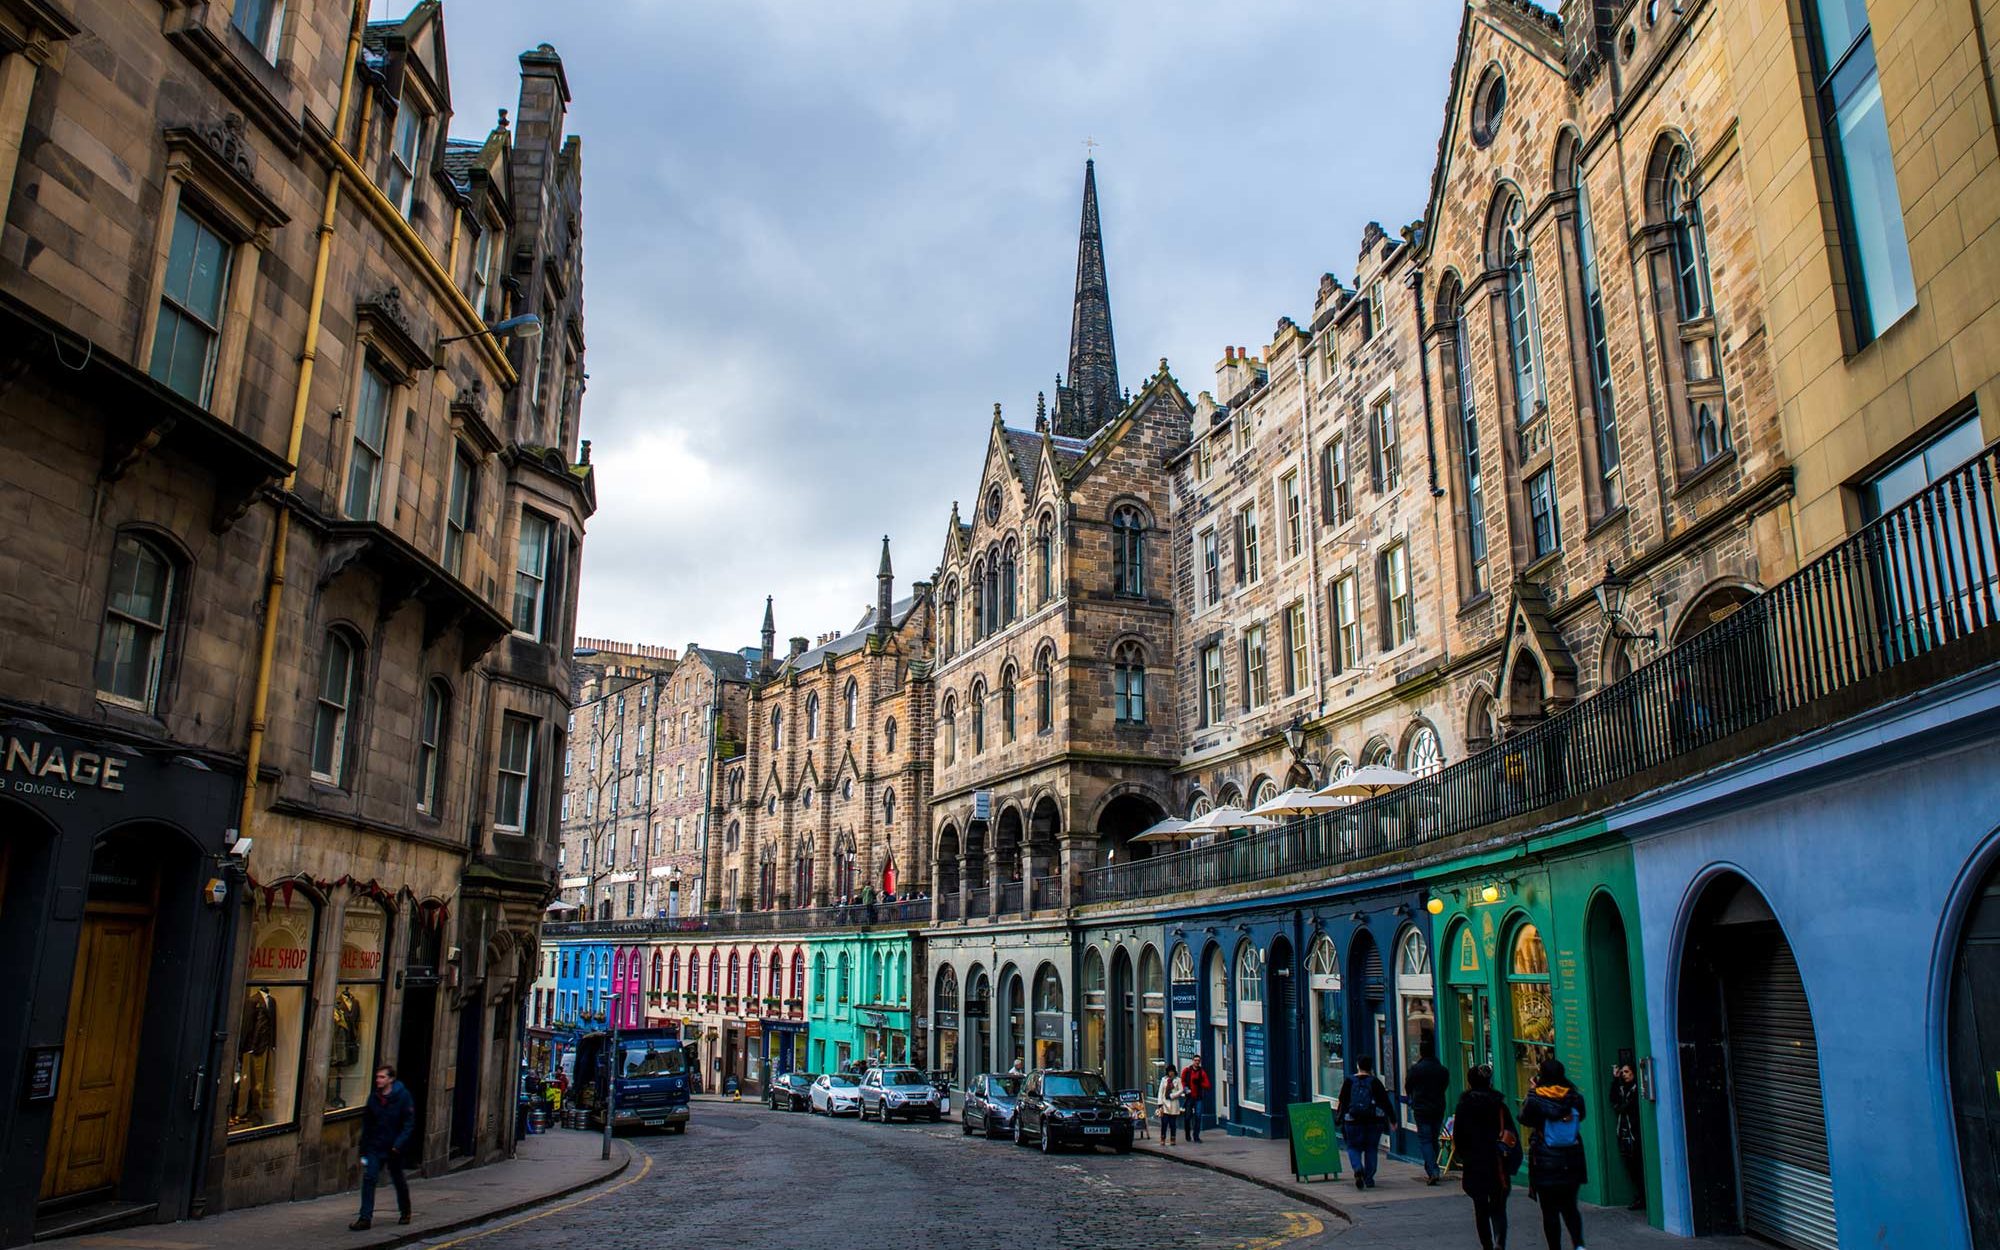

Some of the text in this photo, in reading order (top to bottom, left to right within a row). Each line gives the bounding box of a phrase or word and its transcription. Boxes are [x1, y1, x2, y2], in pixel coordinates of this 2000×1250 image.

[0, 736, 127, 791] NAGE
[14, 782, 76, 799] COMPLEX
[278, 947, 307, 969] SHOP
[360, 950, 381, 969] SHOP
